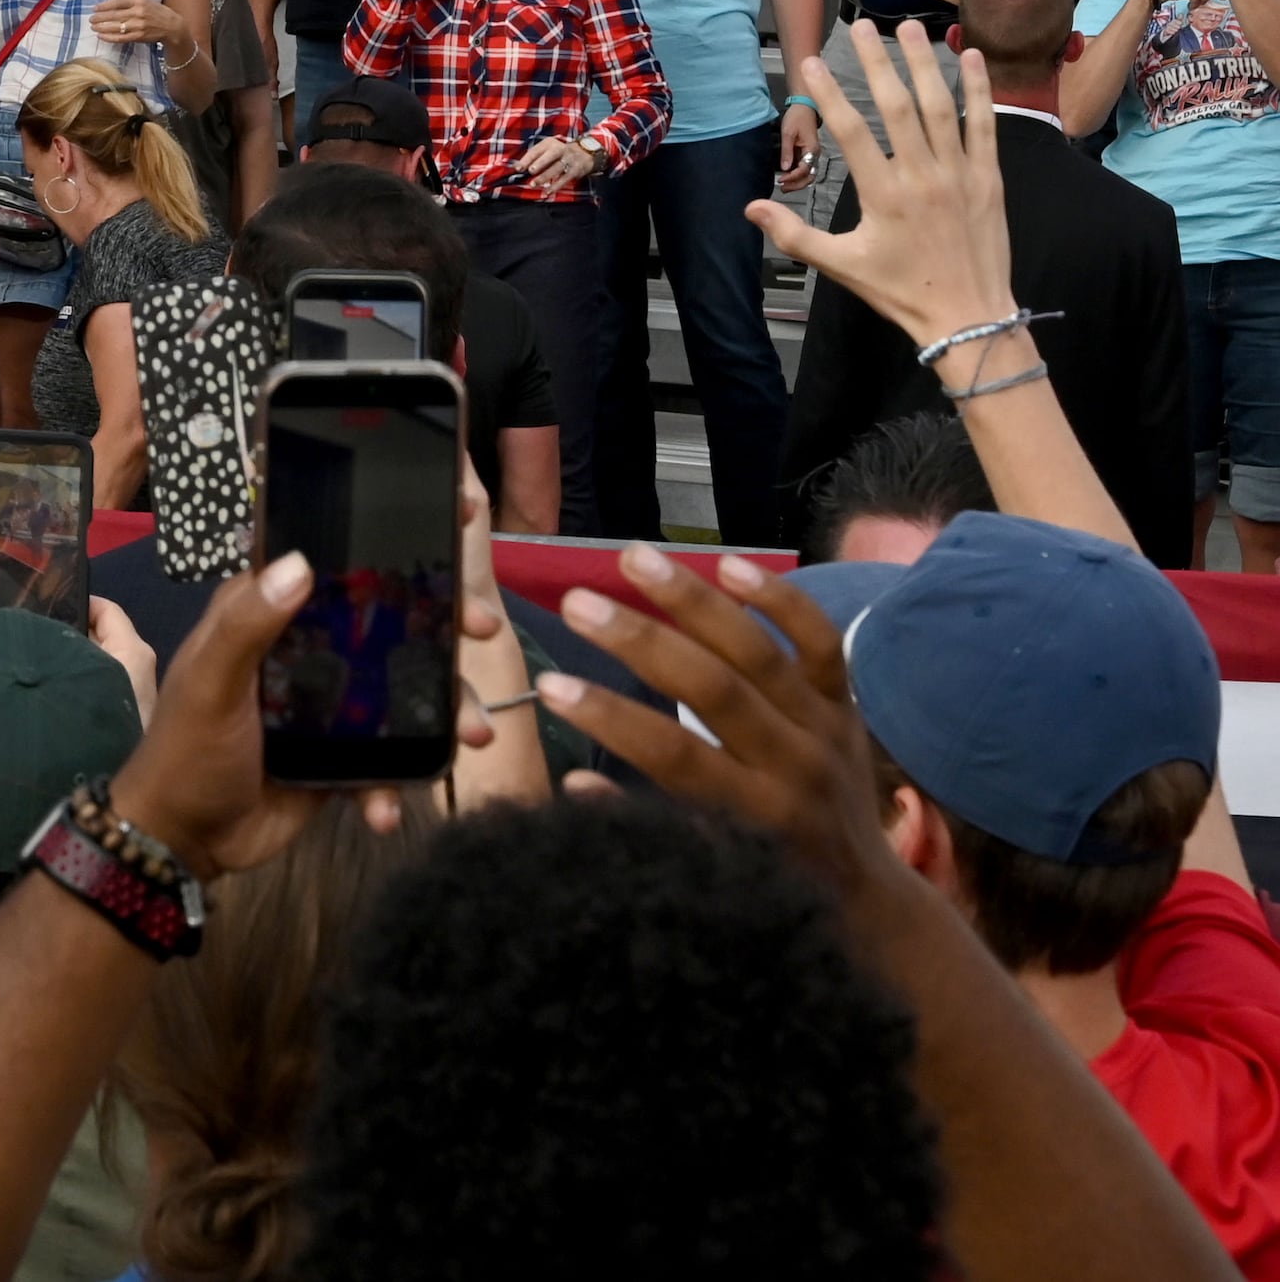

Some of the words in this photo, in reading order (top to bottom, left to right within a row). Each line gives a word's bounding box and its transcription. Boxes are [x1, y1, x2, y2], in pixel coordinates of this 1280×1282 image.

[1147, 61, 1212, 100] DONALD
[1217, 56, 1268, 82] TRUM
[1171, 79, 1253, 110] RALLY
[1184, 102, 1226, 120] DALTON,
[1229, 99, 1243, 111] GA
